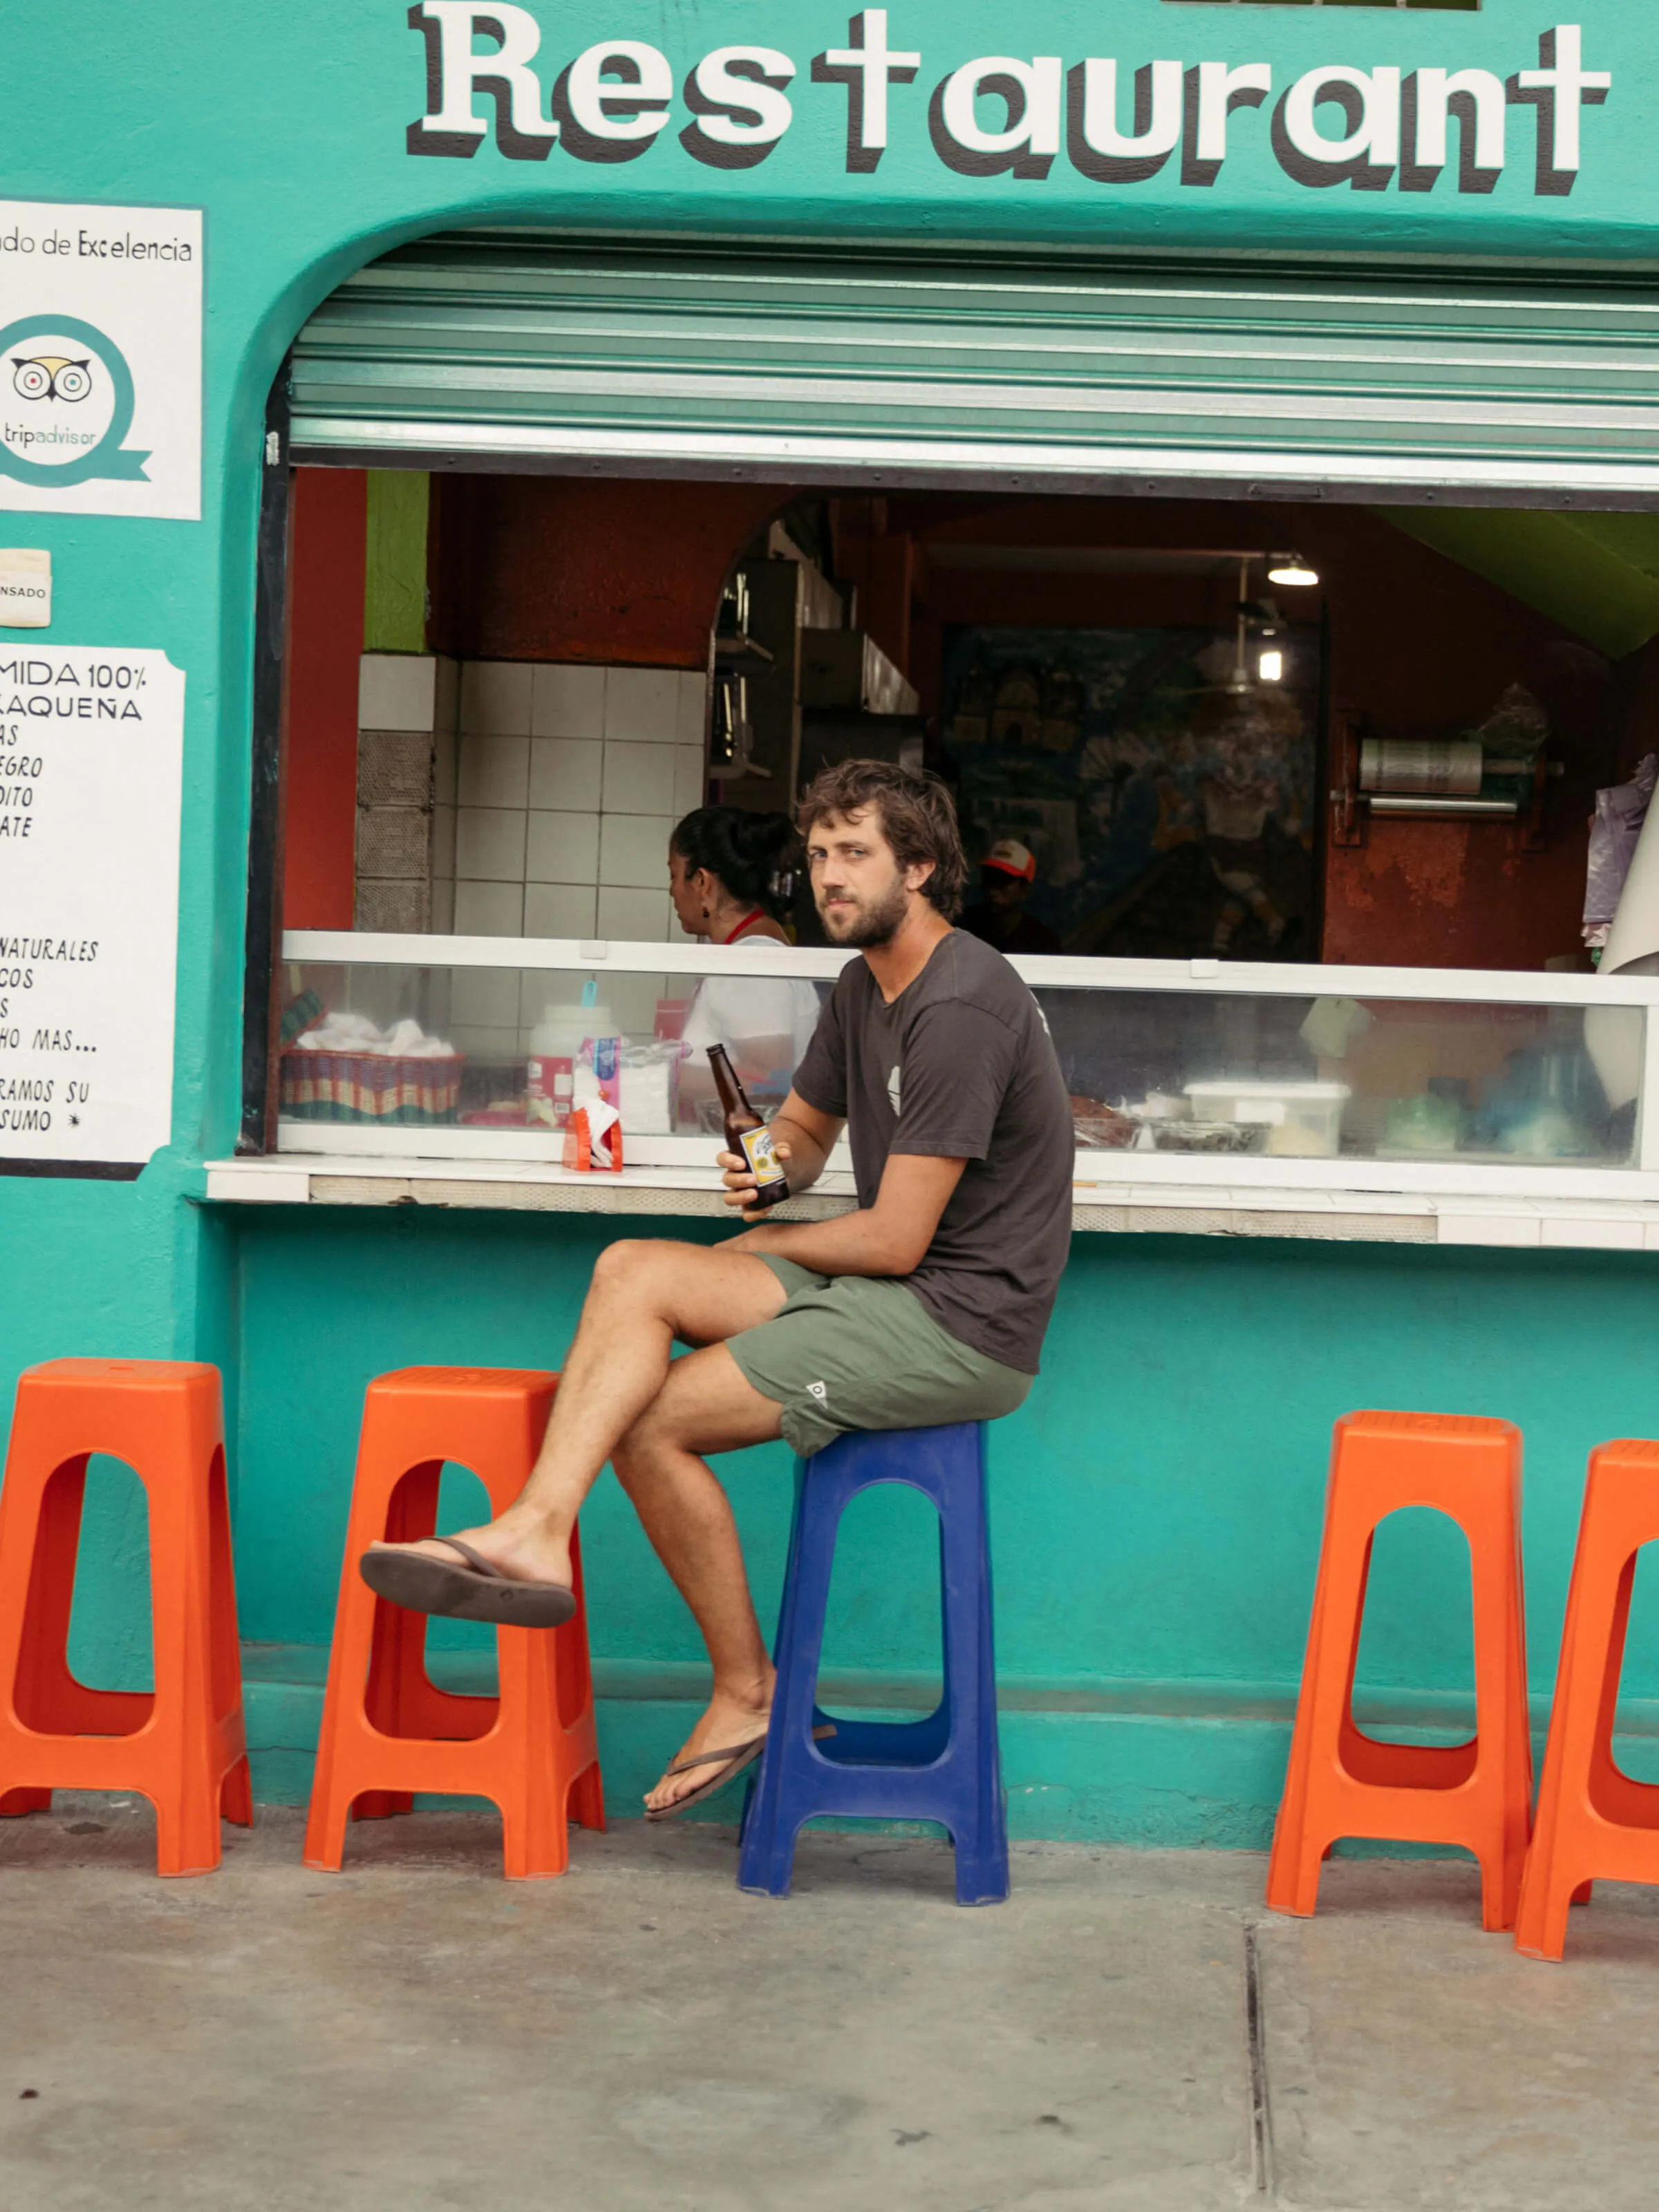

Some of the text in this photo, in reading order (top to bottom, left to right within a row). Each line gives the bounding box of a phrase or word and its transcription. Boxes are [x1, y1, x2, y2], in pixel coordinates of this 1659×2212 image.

[406, 0, 1611, 196] Restaurant
[0, 226, 192, 261] do de Excelencia
[5, 422, 97, 449] tripadvisor
[0, 585, 46, 599] NSADO
[0, 660, 147, 691] MIDA 100%
[0, 693, 142, 721] AQUEÑA
[0, 815, 32, 838] ATE
[0, 937, 99, 962] NATURALES
[0, 967, 33, 989] COS
[66, 1080, 89, 1104] SU
[0, 1109, 51, 1132] SUMO
